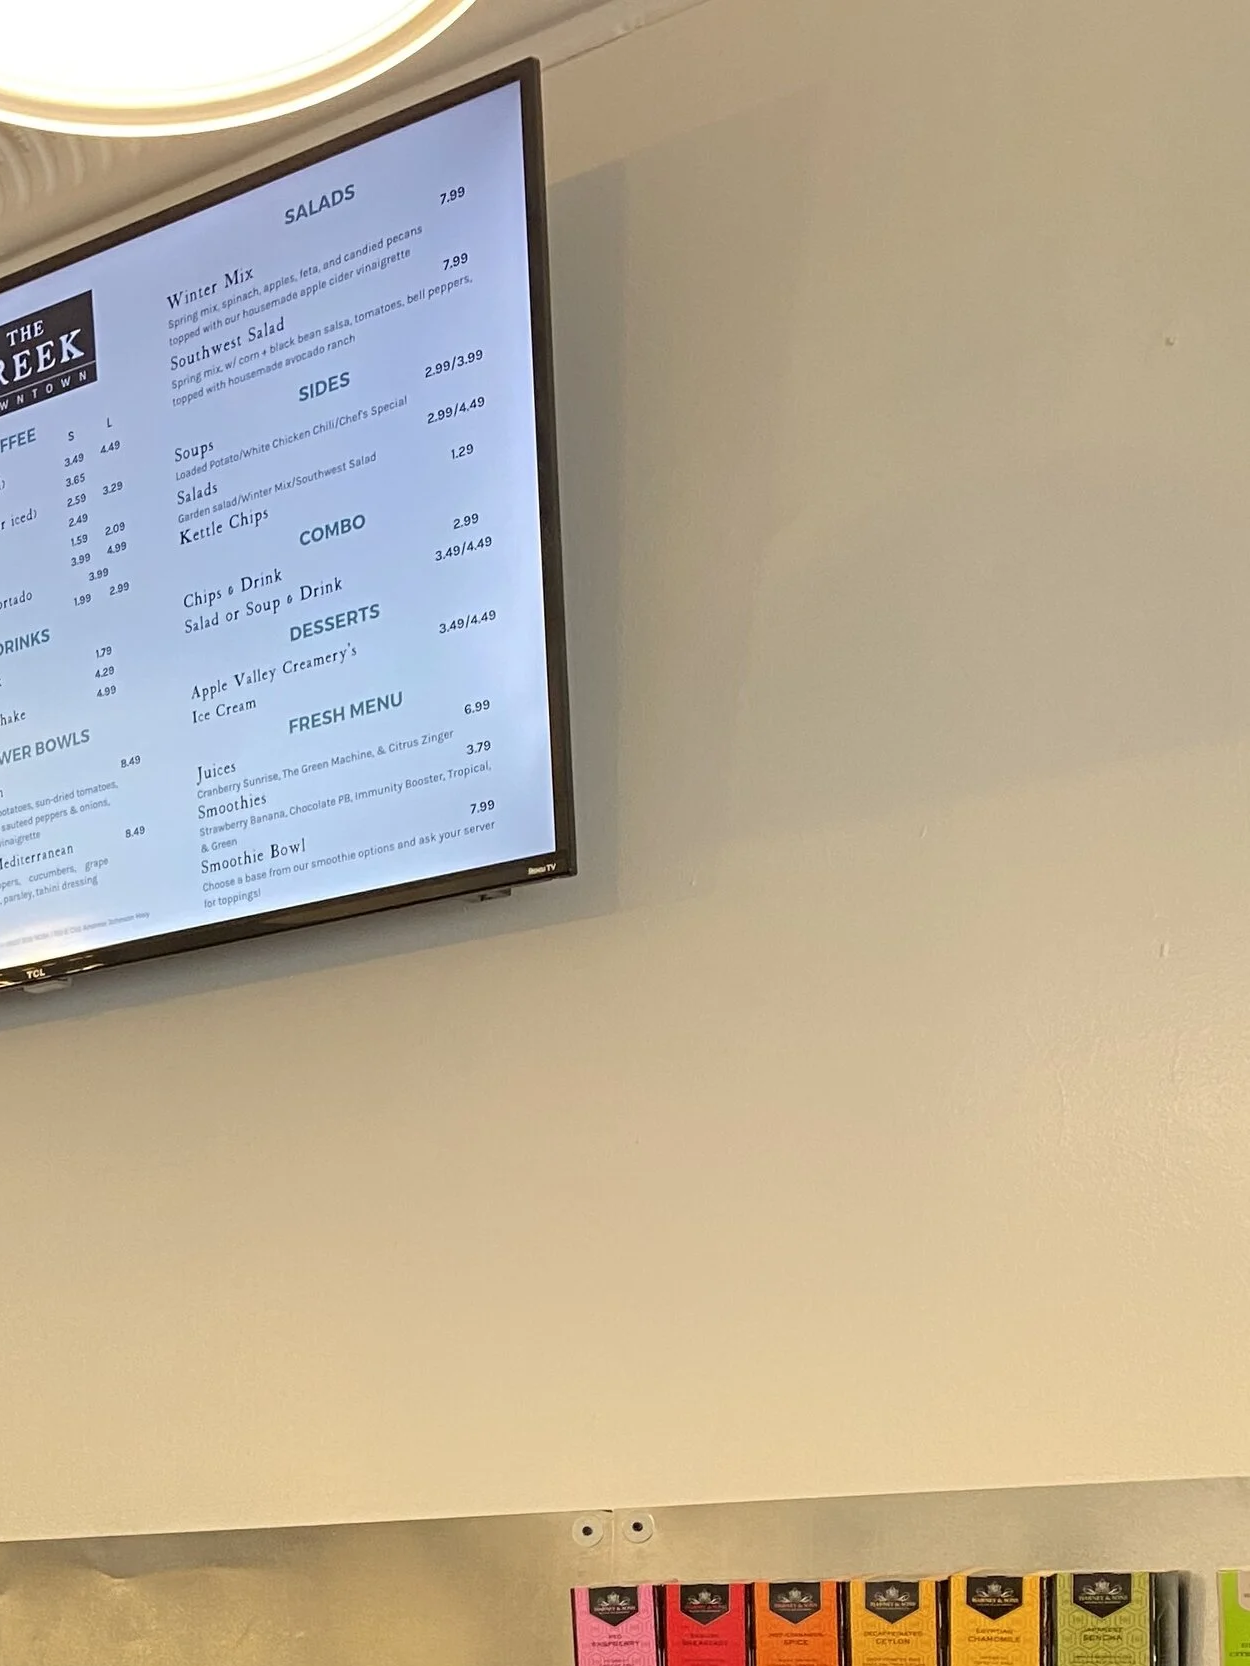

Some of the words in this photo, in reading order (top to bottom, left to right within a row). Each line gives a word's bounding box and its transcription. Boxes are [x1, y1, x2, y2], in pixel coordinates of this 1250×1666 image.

[283, 182, 355, 225] SALADS
[438, 185, 466, 206] 7.99
[442, 251, 468, 271] 7.99
[165, 282, 218, 310] Winter
[223, 267, 254, 289] Mix
[4, 318, 44, 347] THE
[169, 334, 242, 371] Southwest
[247, 314, 285, 343] Salad
[424, 348, 483, 379] 2.99/3.99
[298, 370, 350, 402] SIDES
[105, 416, 113, 428] L
[426, 395, 485, 425] 2.99/4.49
[67, 429, 75, 442] S
[99, 439, 121, 454] 4.49
[174, 460, 208, 481] Loaded
[208, 442, 271, 470] Potato/White
[271, 429, 311, 449] Chicken
[369, 394, 408, 417] Special
[63, 451, 85, 468] 3.49
[173, 440, 214, 463] Soups
[450, 442, 474, 460] 1.29
[176, 480, 218, 505] Salads
[178, 519, 223, 545] Kettle
[228, 508, 269, 529] Chips
[298, 513, 366, 546] COMBO
[452, 511, 479, 530] 2.99
[434, 534, 492, 562] 3.49/4.49
[288, 602, 380, 642] DESSERTS
[438, 608, 496, 634] 3.49/4.49
[190, 678, 228, 702] Apple
[232, 667, 276, 687] Valley
[281, 641, 357, 674] Creamery's
[191, 709, 211, 724] Ice
[214, 698, 257, 717] Cream
[288, 704, 345, 734] FRESH
[349, 690, 403, 719] MENU
[463, 698, 490, 715] 6.99
[34, 727, 90, 756] BOWLS
[465, 739, 491, 756] 3.79
[195, 762, 236, 786] Juices
[196, 793, 267, 820] Smoothies
[469, 798, 495, 815] 7.99
[200, 849, 264, 874] Smoothie
[269, 836, 306, 859] Bowl
[26, 968, 46, 979] TCL
